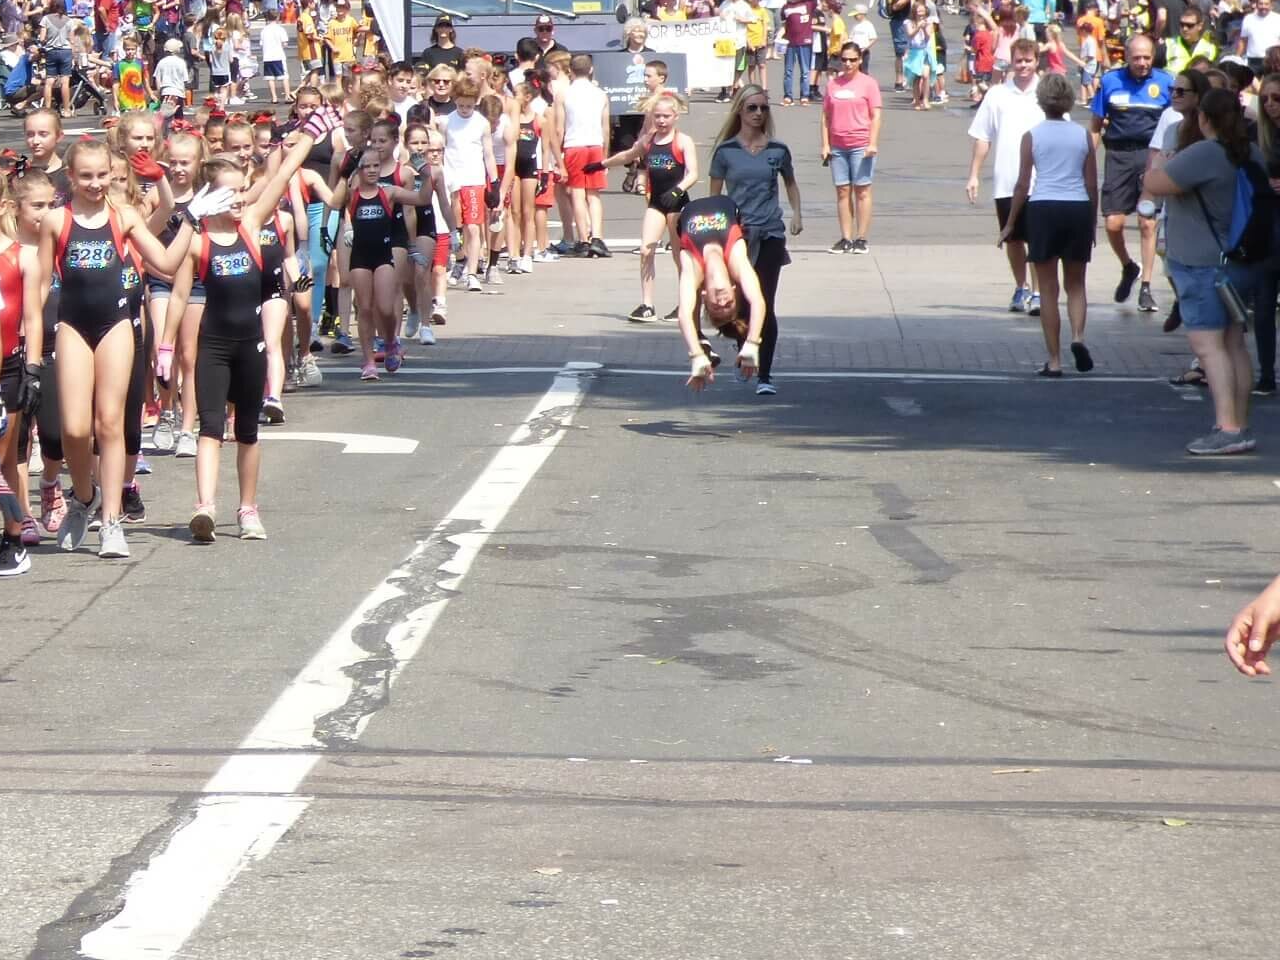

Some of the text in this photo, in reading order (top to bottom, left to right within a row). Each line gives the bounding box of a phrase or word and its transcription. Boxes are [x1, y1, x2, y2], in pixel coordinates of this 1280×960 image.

[358, 206, 384, 216] 5280
[70, 248, 114, 262] 5280
[216, 256, 249, 272] 5280
